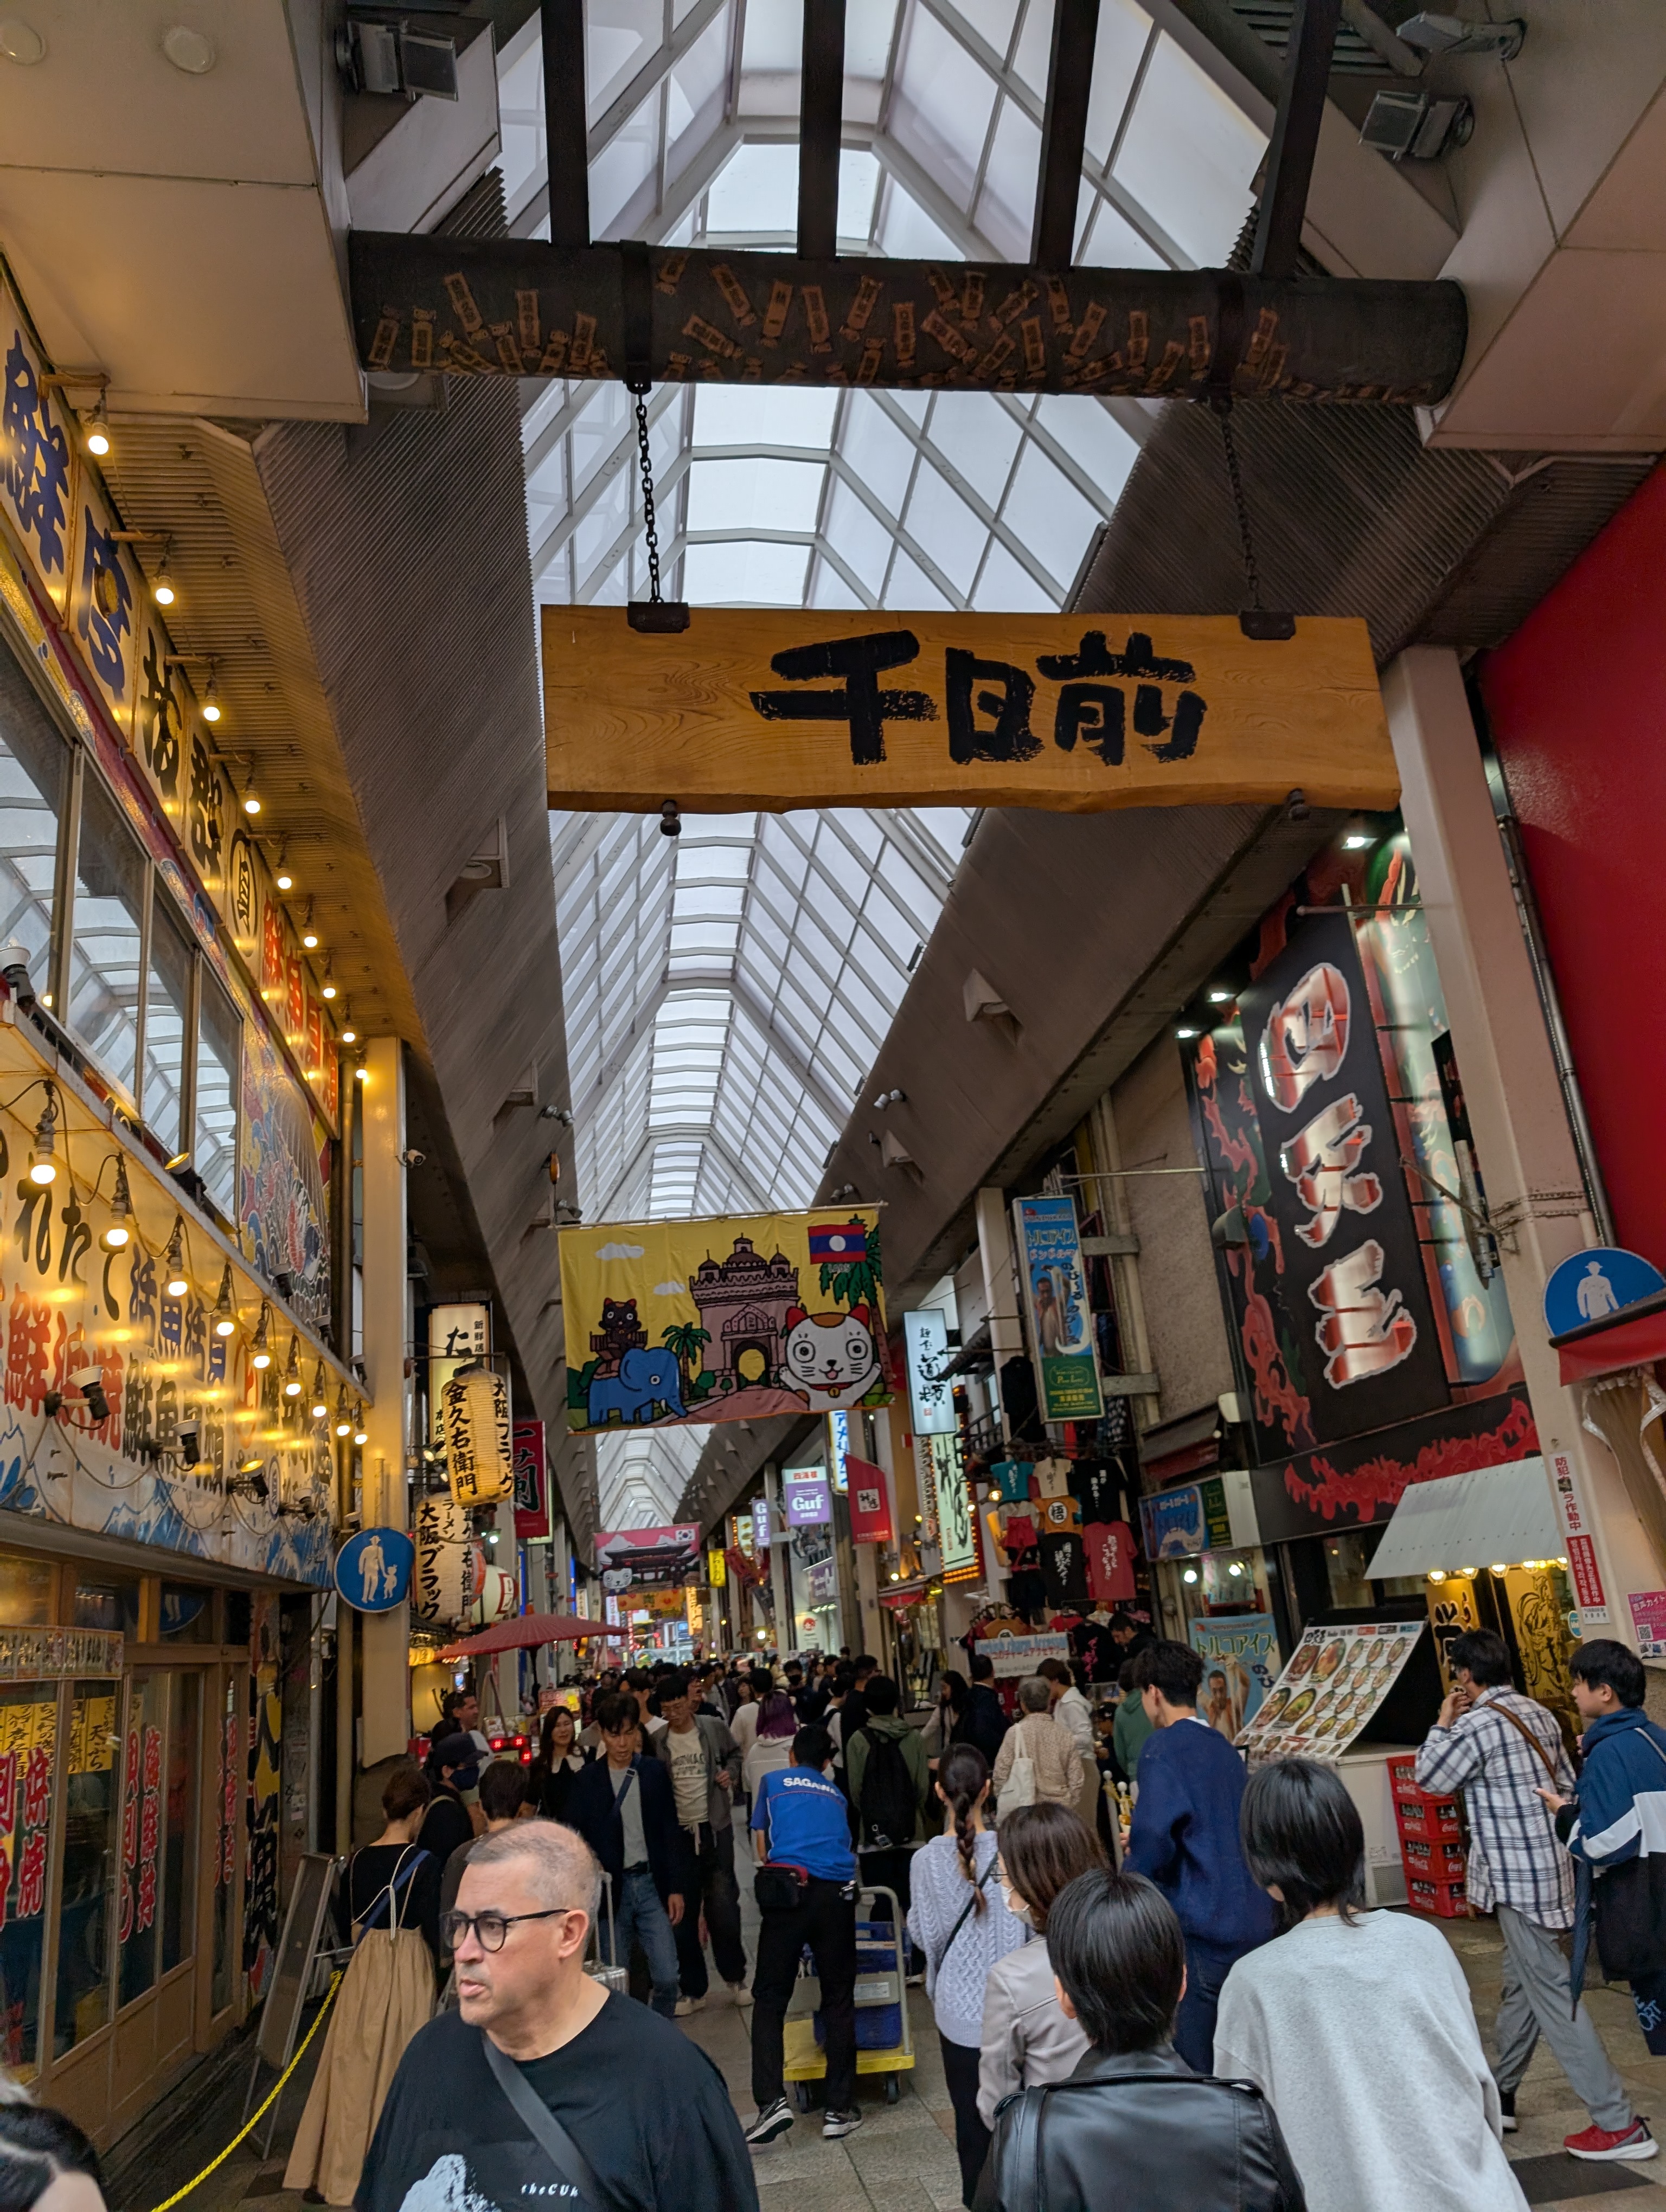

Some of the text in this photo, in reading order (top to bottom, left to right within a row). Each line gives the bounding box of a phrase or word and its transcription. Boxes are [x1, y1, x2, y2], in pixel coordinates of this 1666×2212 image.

[749, 630, 1207, 766] 千日前
[474, 1320, 484, 1359] 新鮮居
[446, 1381, 478, 1500] 金久右衛門
[494, 1377, 514, 1494] 大阪ブラク
[442, 1499, 454, 1541] ラーメン
[791, 1494, 824, 1511] Guf
[1555, 1456, 1582, 1531] 防犯ラ作動中
[419, 1502, 444, 1621] 大阪ブラック
[461, 1505, 472, 1616] 久右衛門
[1195, 1632, 1276, 1657] トルコアイス
